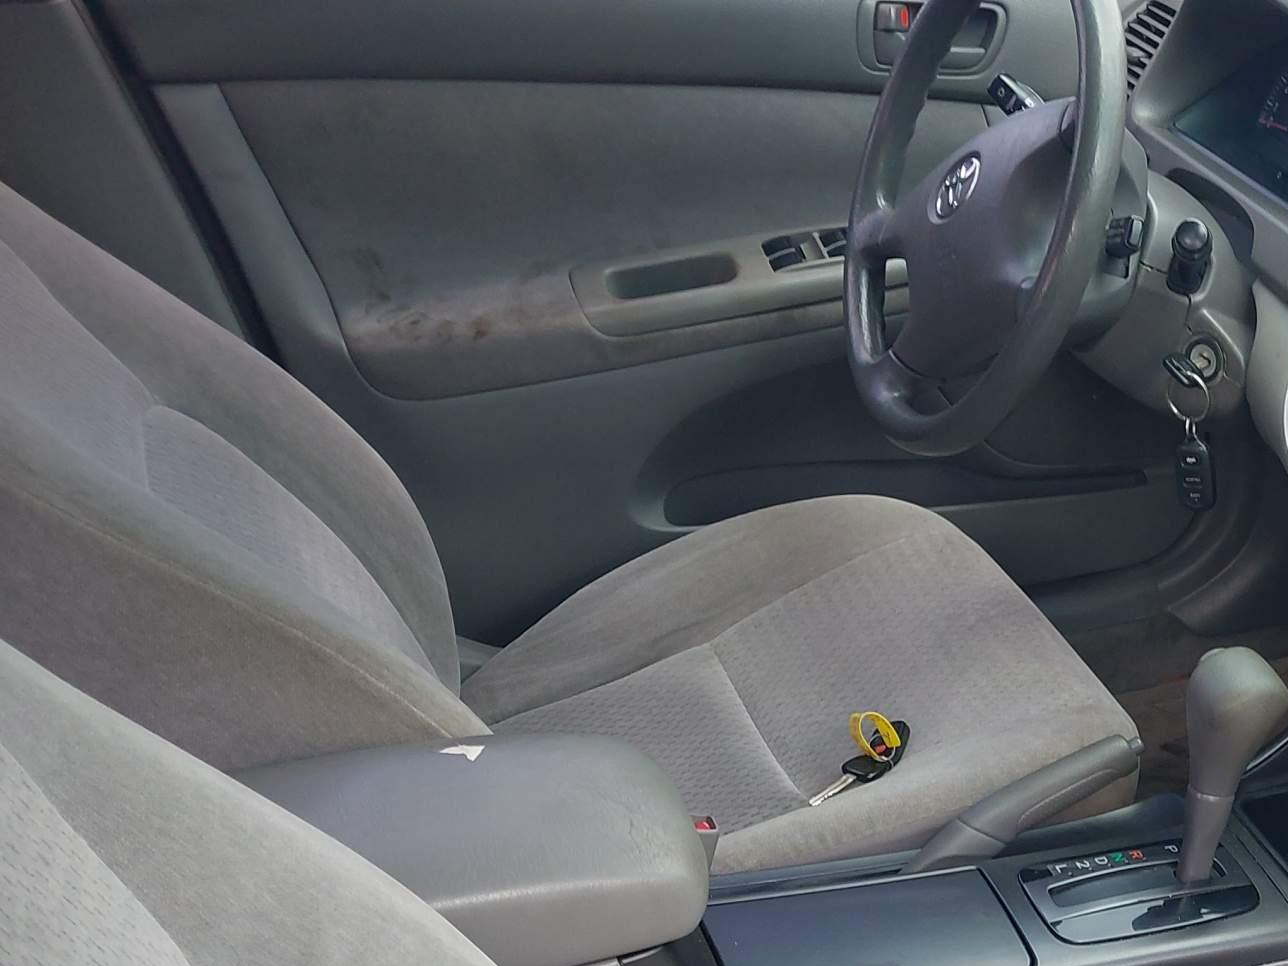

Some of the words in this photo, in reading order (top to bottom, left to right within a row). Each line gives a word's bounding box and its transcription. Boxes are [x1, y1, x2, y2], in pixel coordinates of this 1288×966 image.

[1164, 844, 1178, 853] P
[1112, 852, 1124, 863] N
[1129, 849, 1145, 860] R
[1075, 860, 1090, 870] 2
[1094, 856, 1108, 865] D
[1055, 863, 1068, 873] L
